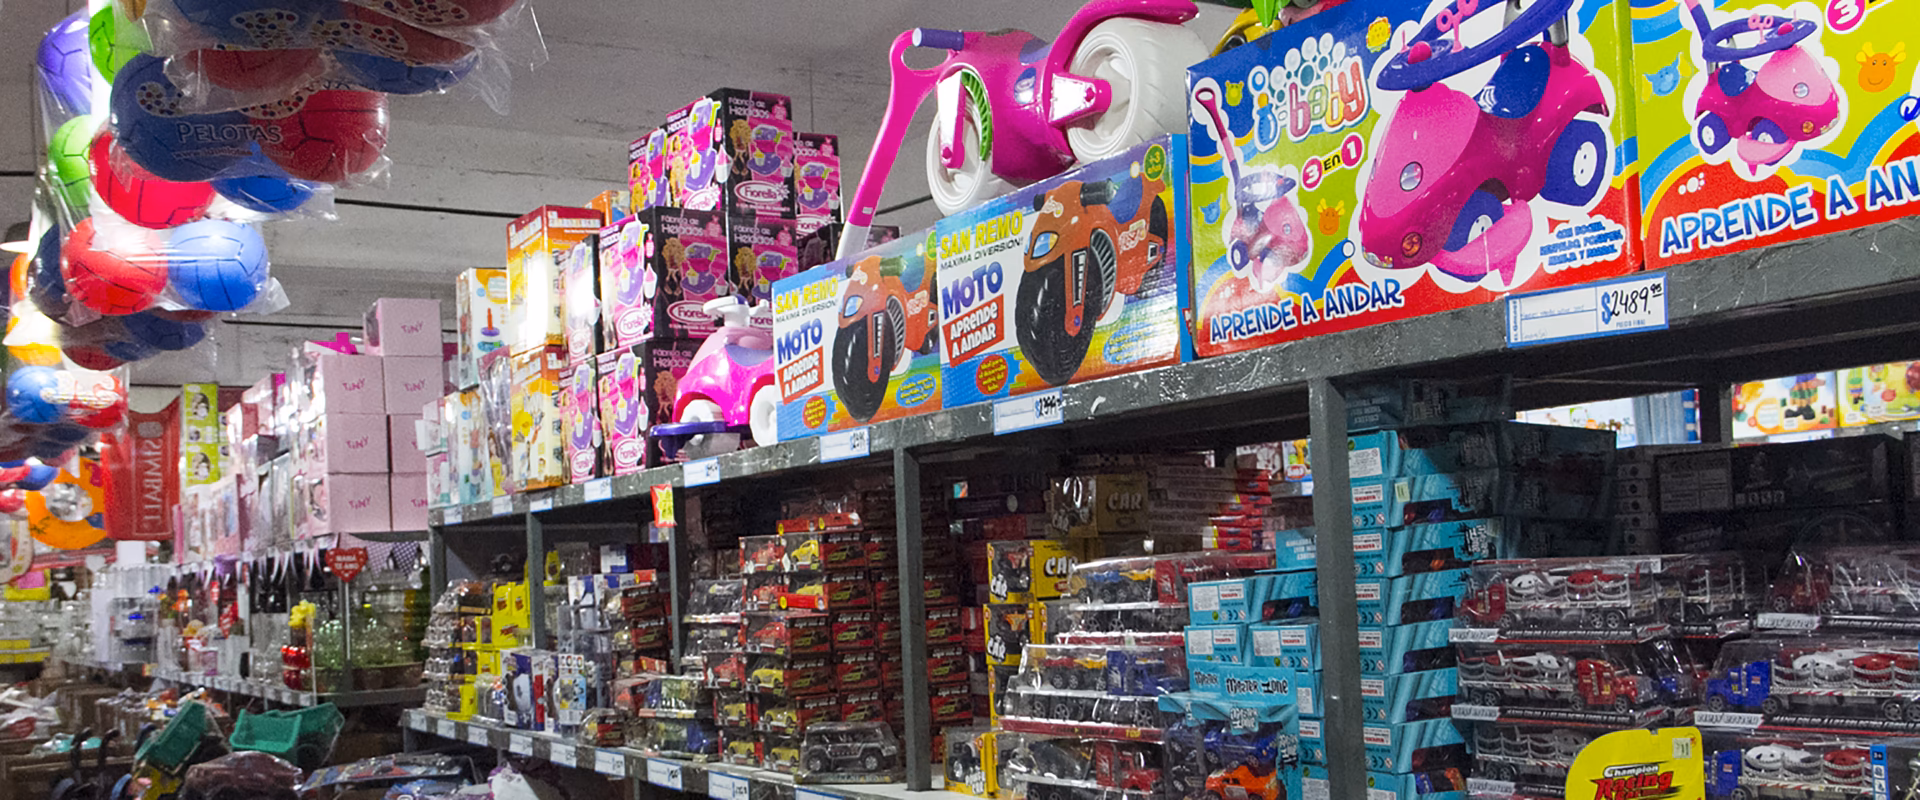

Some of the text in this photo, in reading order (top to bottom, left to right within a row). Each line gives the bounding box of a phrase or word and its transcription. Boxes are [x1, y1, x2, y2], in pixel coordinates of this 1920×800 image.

[176, 122, 283, 143] PELOTAS
[1304, 164, 1320, 184] 3
[1347, 141, 1358, 160] 1
[1661, 185, 1816, 255] APRENDE
[1828, 178, 1856, 216] A
[940, 209, 1024, 260] SAN REMO
[940, 254, 972, 271] MAXIMA
[775, 276, 839, 316] SAN REMO
[941, 260, 1004, 321] MOTO
[1210, 278, 1404, 343] APRENDE A ANDAR
[776, 317, 824, 366] MOTO
[952, 341, 960, 359] A
[411, 499, 429, 508] TIN
[1108, 491, 1142, 512] CAR
[1591, 771, 1674, 800] Racing
[1603, 763, 1660, 779] Champion
